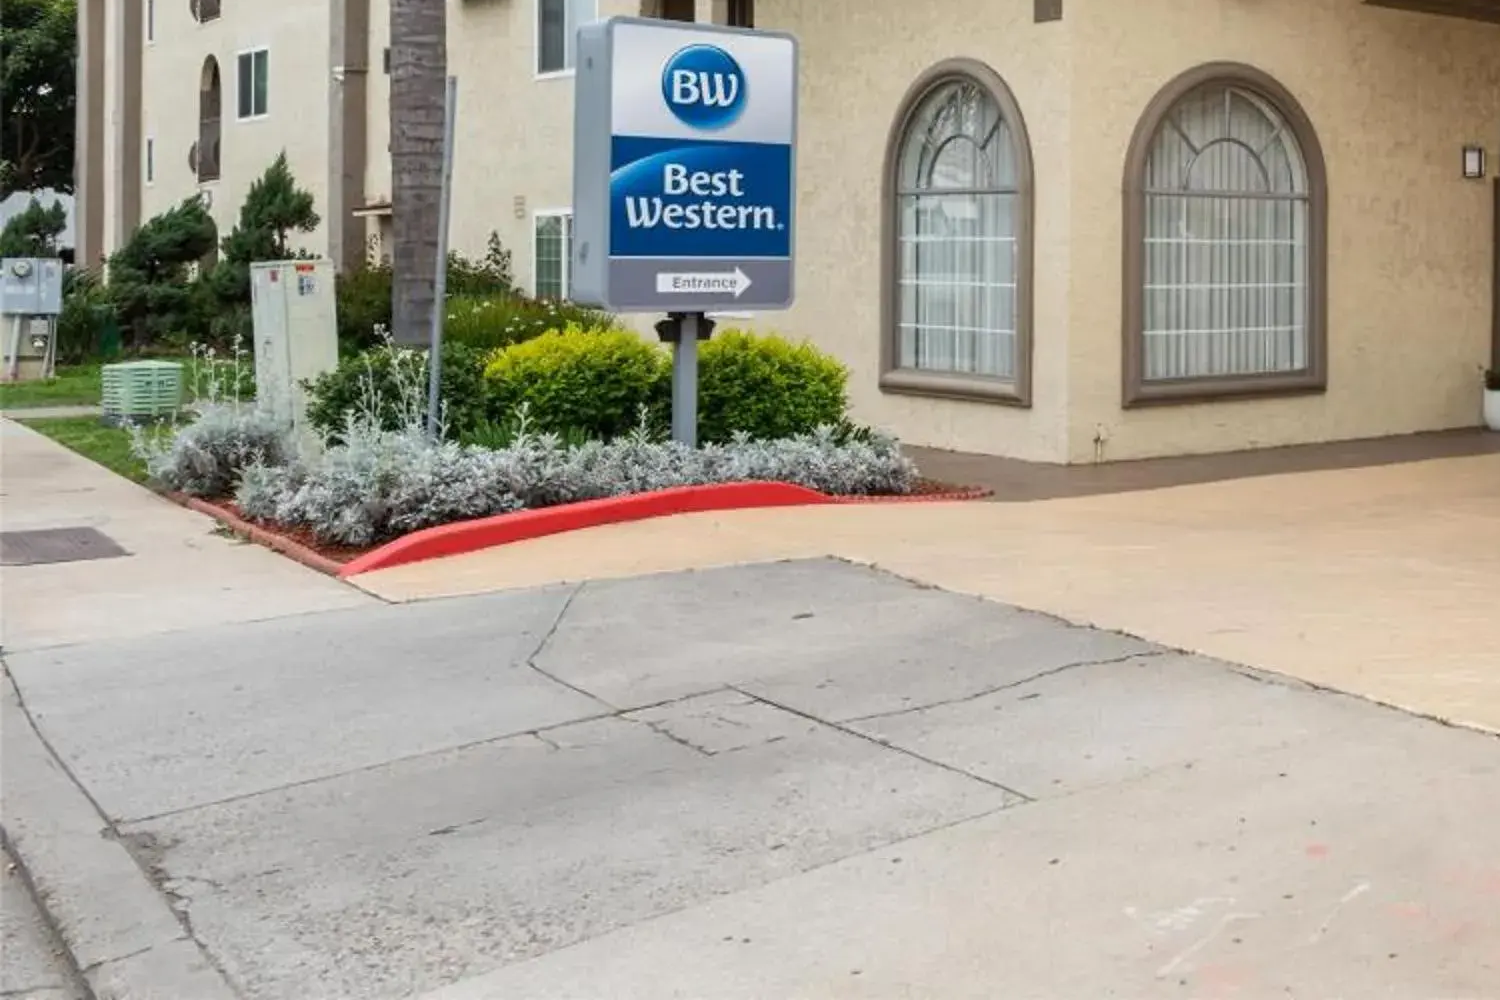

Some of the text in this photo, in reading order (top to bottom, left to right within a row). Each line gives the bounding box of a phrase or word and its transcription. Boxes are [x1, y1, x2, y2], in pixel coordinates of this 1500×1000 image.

[671, 68, 739, 107] BW
[664, 163, 744, 197] Best
[671, 276, 738, 290] Entrance
